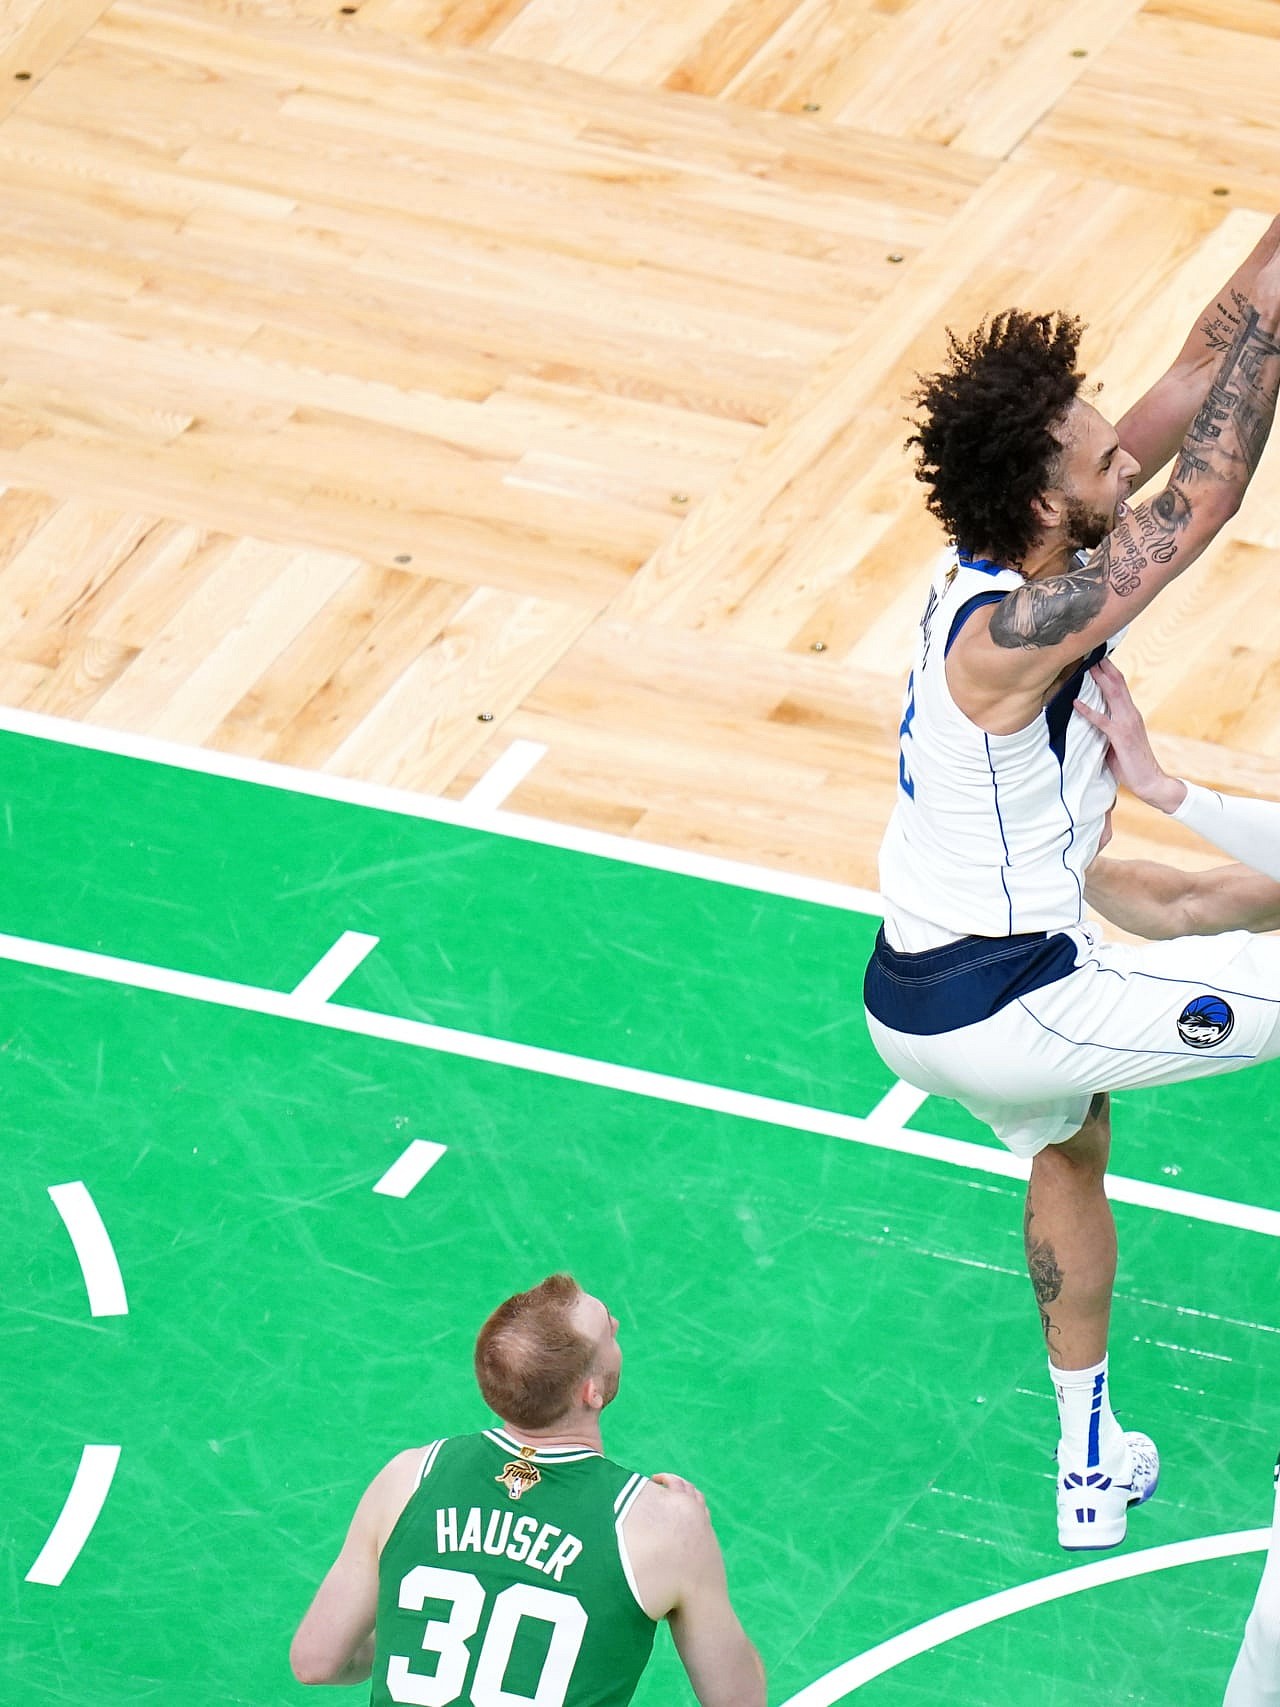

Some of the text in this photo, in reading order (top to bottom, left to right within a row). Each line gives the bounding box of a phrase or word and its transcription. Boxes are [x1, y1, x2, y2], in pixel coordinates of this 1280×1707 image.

[498, 1463, 539, 1481] Finals
[436, 1507, 583, 1582] HAUSER
[386, 1565, 589, 1707] 30
